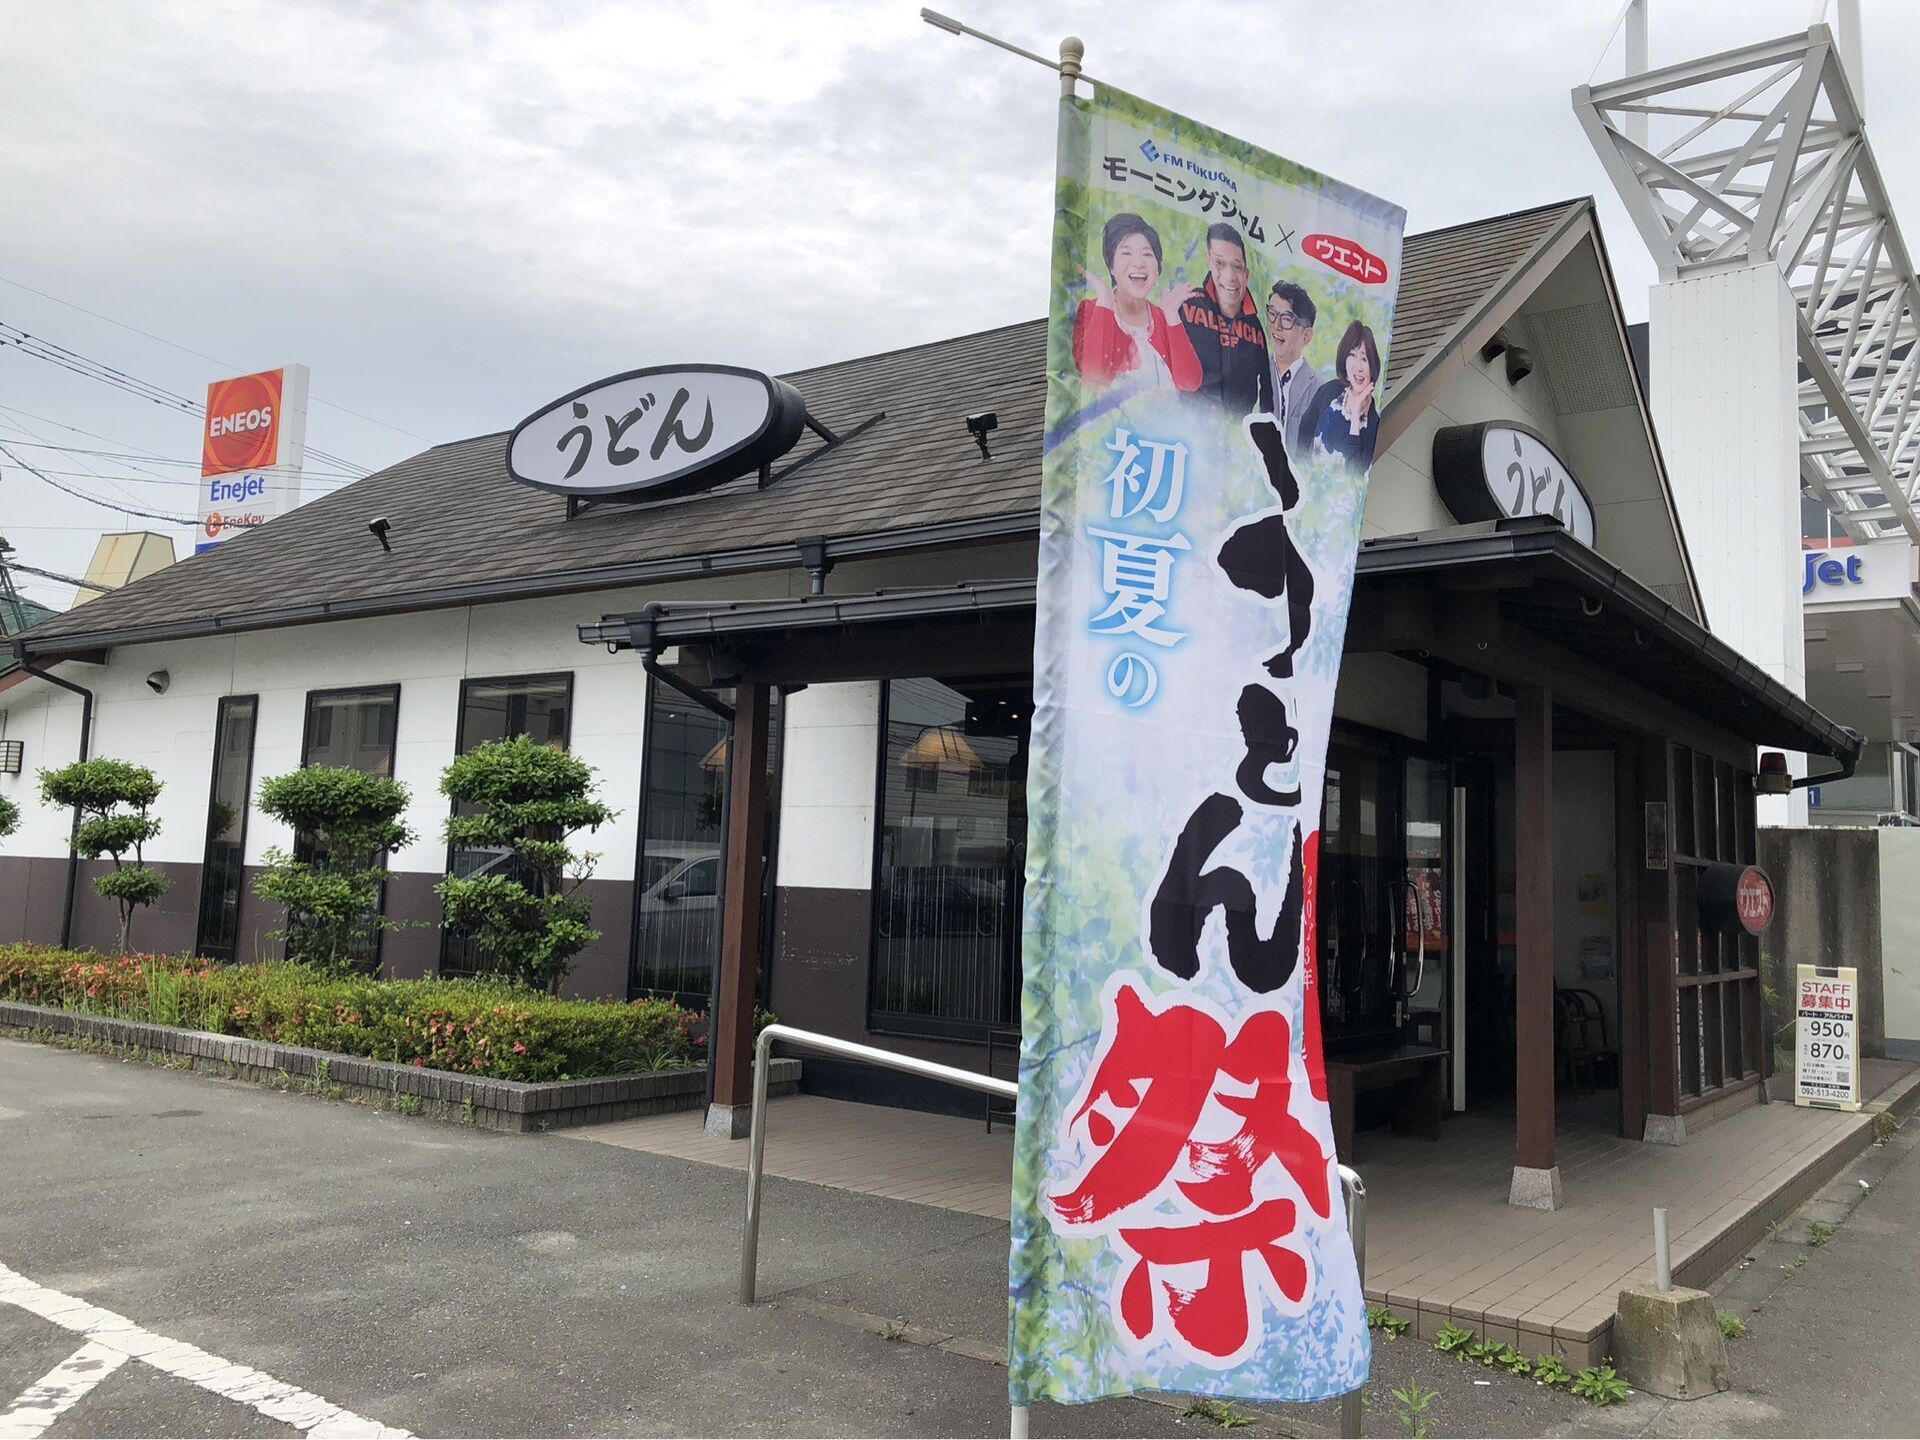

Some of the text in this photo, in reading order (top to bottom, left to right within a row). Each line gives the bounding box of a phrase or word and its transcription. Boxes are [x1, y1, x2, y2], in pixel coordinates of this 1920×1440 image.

[1163, 153, 1238, 193] FM FUKUOKA
[1103, 156, 1266, 244] モーニングジャム
[1315, 238, 1384, 280] ウエスト
[1183, 303, 1265, 349] VALENCIA
[210, 406, 272, 437] ENEOS
[556, 386, 714, 480] うどん
[1087, 427, 1192, 707] 初夏の
[1801, 994, 1851, 1010] 募集中
[1802, 981, 1851, 994] STAFF
